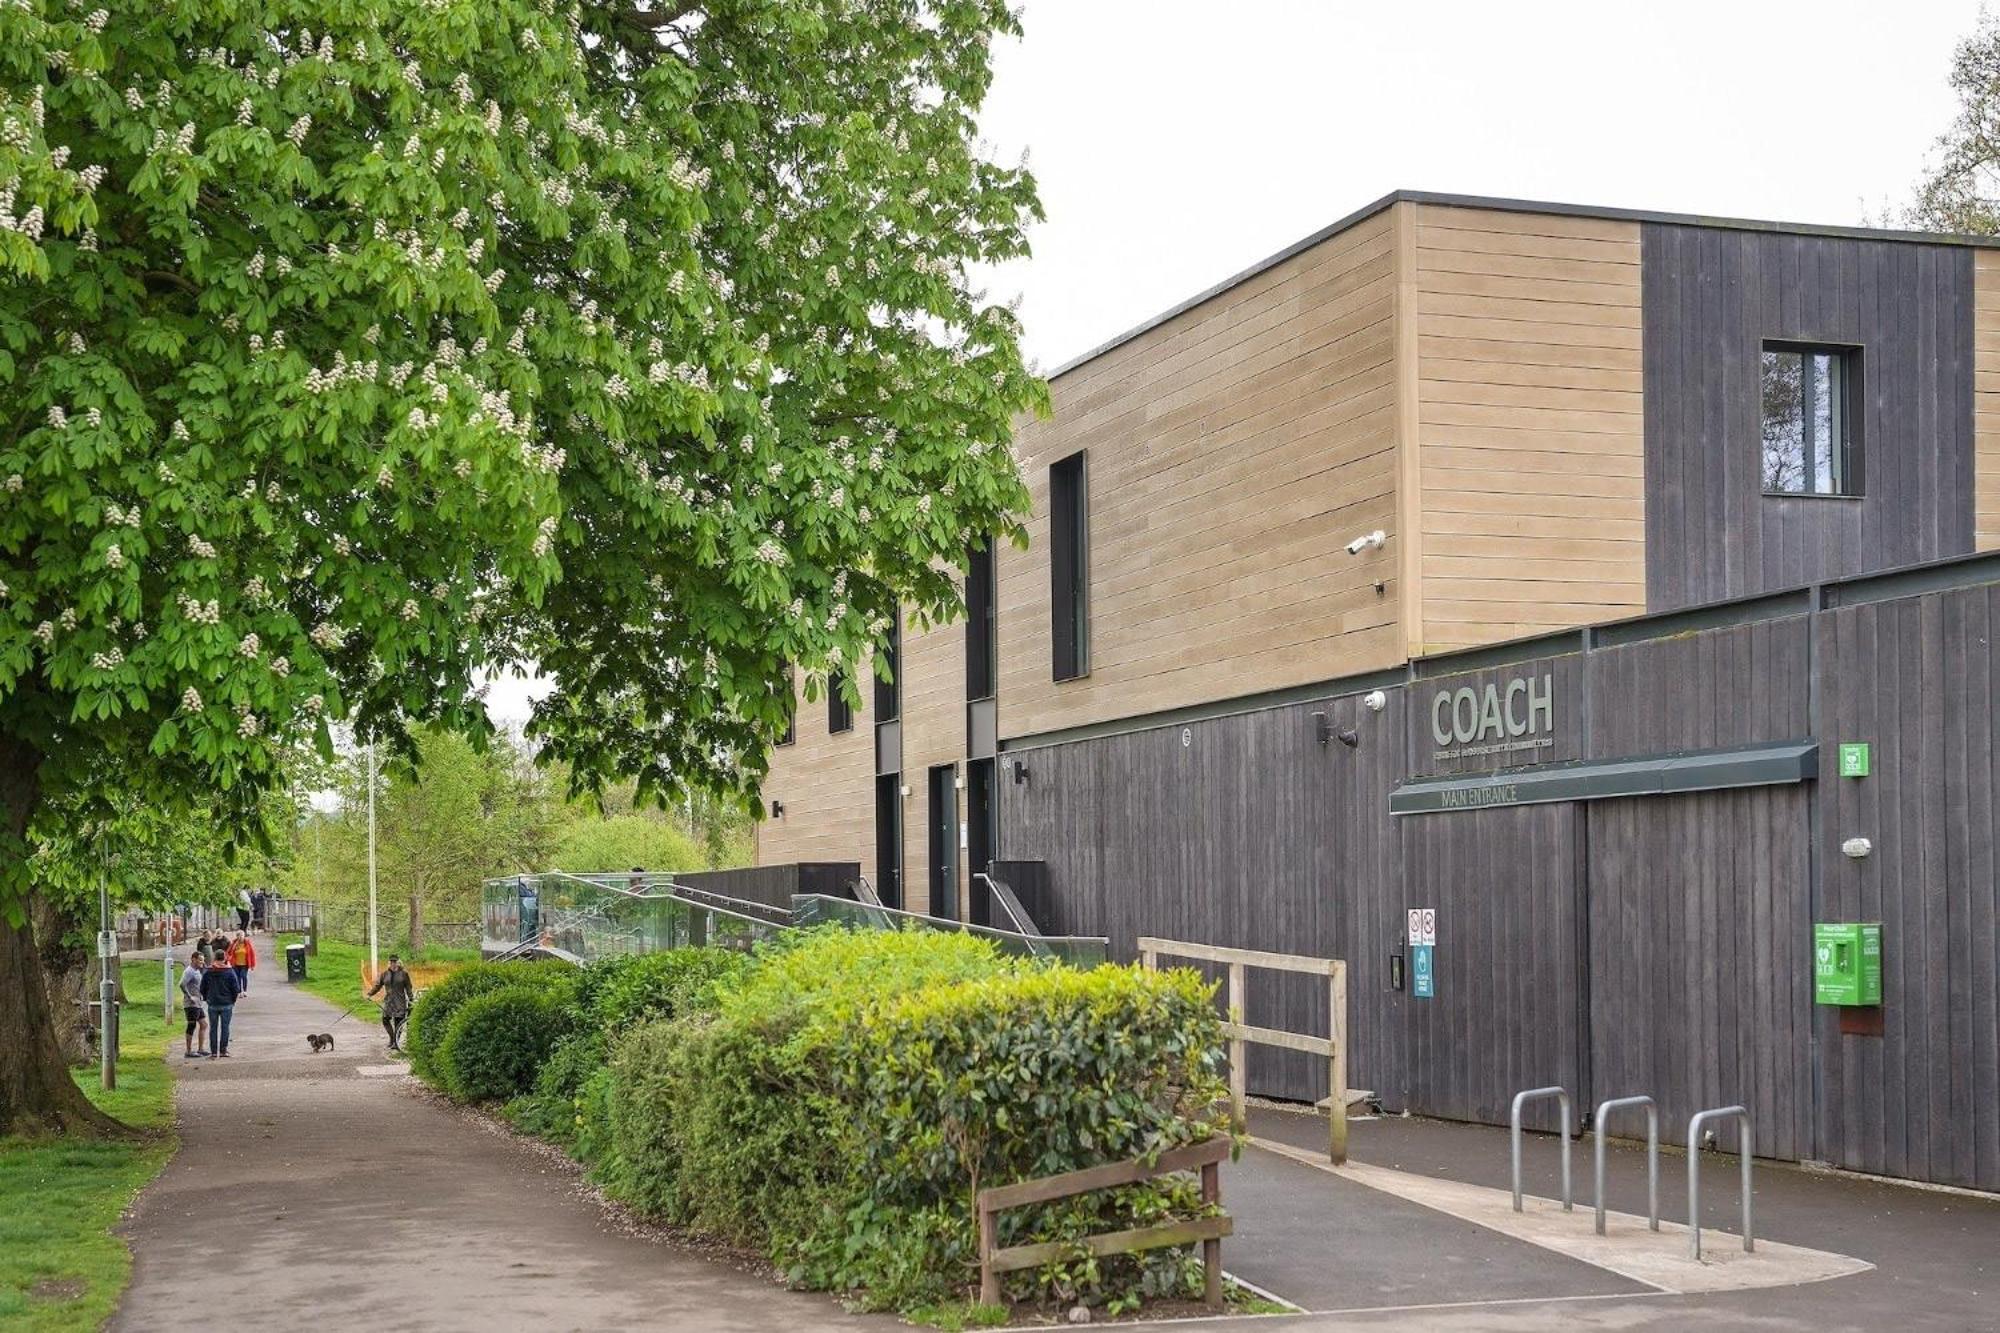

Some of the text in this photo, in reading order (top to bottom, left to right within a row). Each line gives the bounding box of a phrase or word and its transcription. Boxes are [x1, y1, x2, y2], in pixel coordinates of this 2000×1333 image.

[1432, 674, 1552, 746] COACH
[1441, 784, 1517, 807] MAIN ENTRANCE
